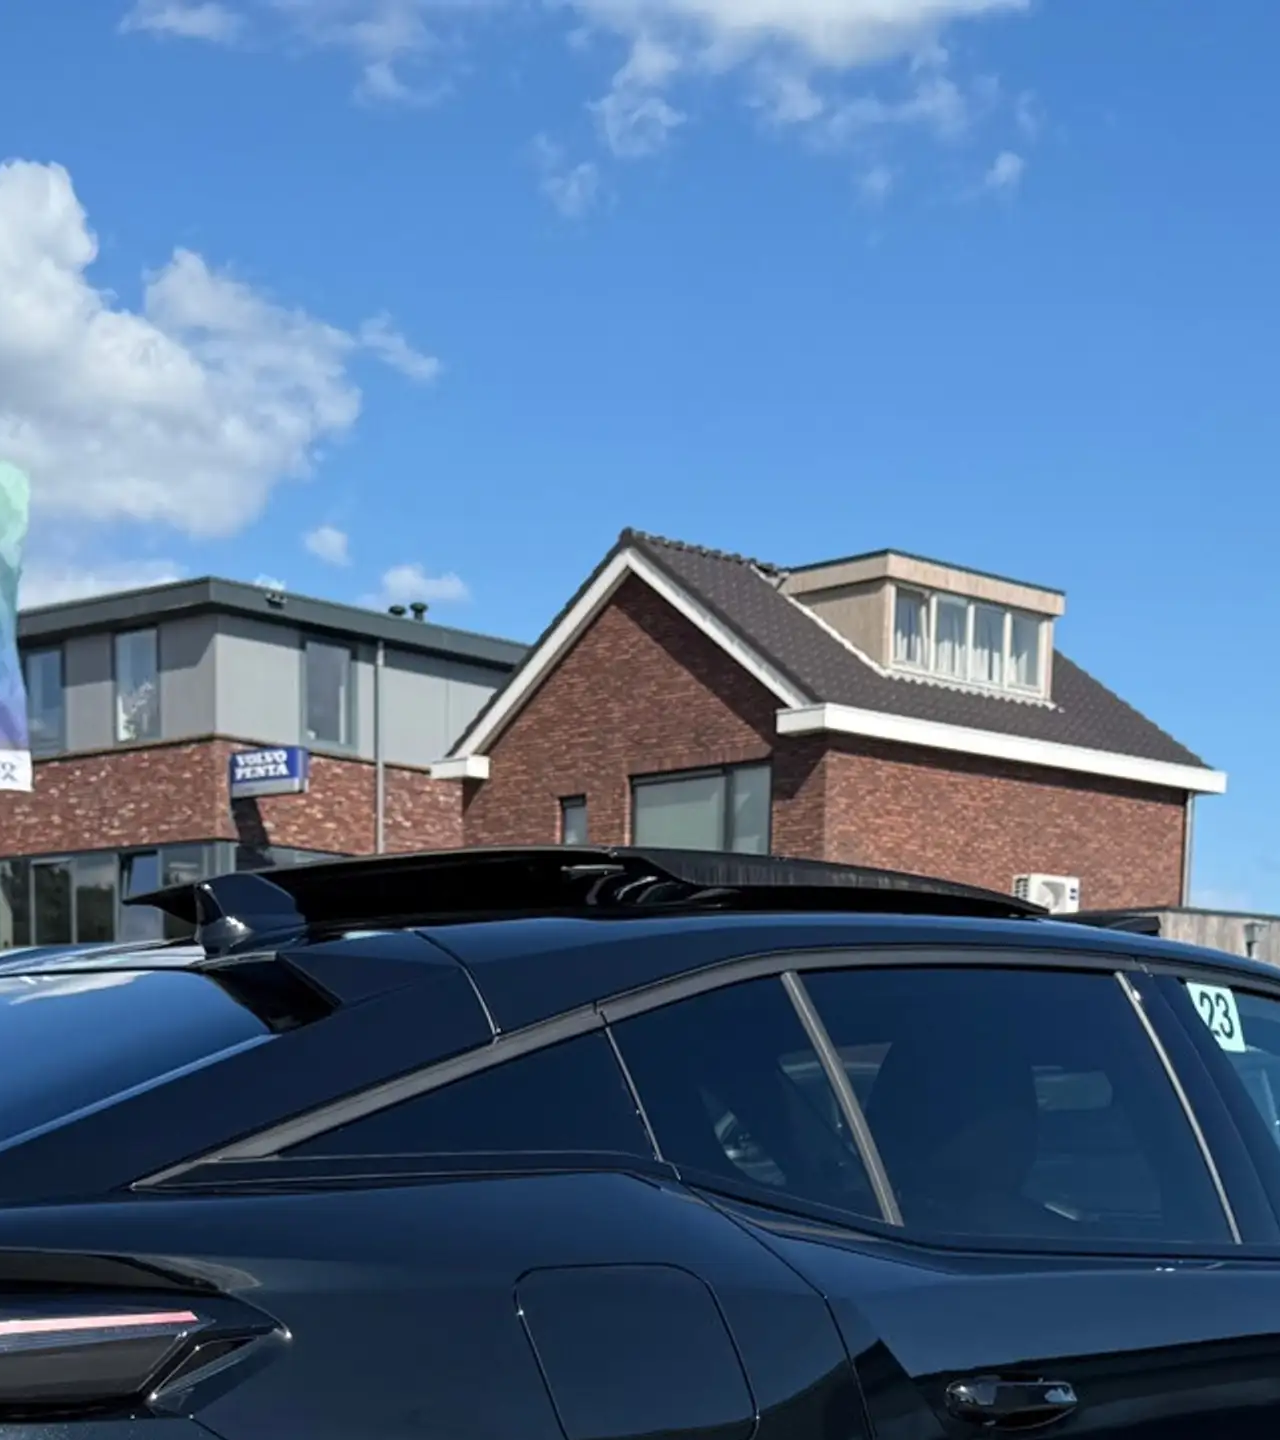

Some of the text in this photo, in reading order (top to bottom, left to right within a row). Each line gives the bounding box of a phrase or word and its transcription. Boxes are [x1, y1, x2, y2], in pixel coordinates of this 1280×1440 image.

[235, 749, 288, 767] VOLVO
[234, 763, 289, 780] PENTA
[1199, 990, 1235, 1040] 23
